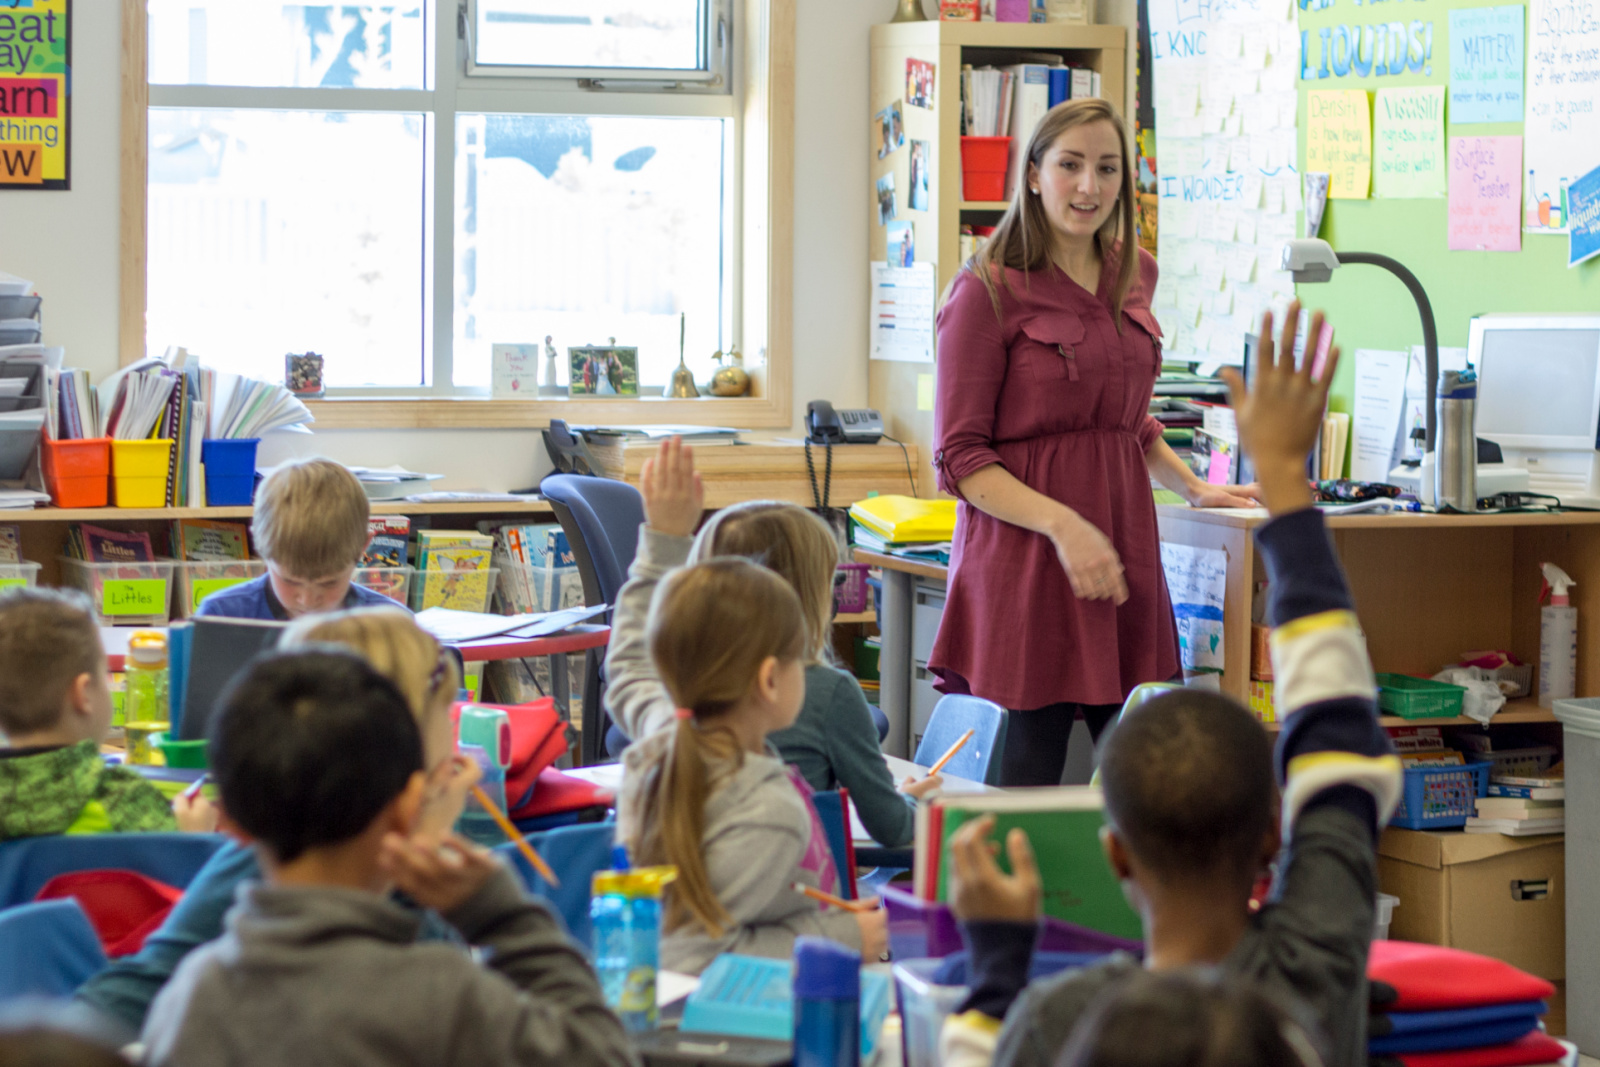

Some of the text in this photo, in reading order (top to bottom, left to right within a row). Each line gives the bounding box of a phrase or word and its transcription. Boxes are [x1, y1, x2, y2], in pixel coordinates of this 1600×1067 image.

[1301, 19, 1433, 80] LIQUIDS!
[1311, 94, 1357, 127] Density
[1161, 174, 1244, 203] I WONDER
[111, 592, 153, 605] Littles
